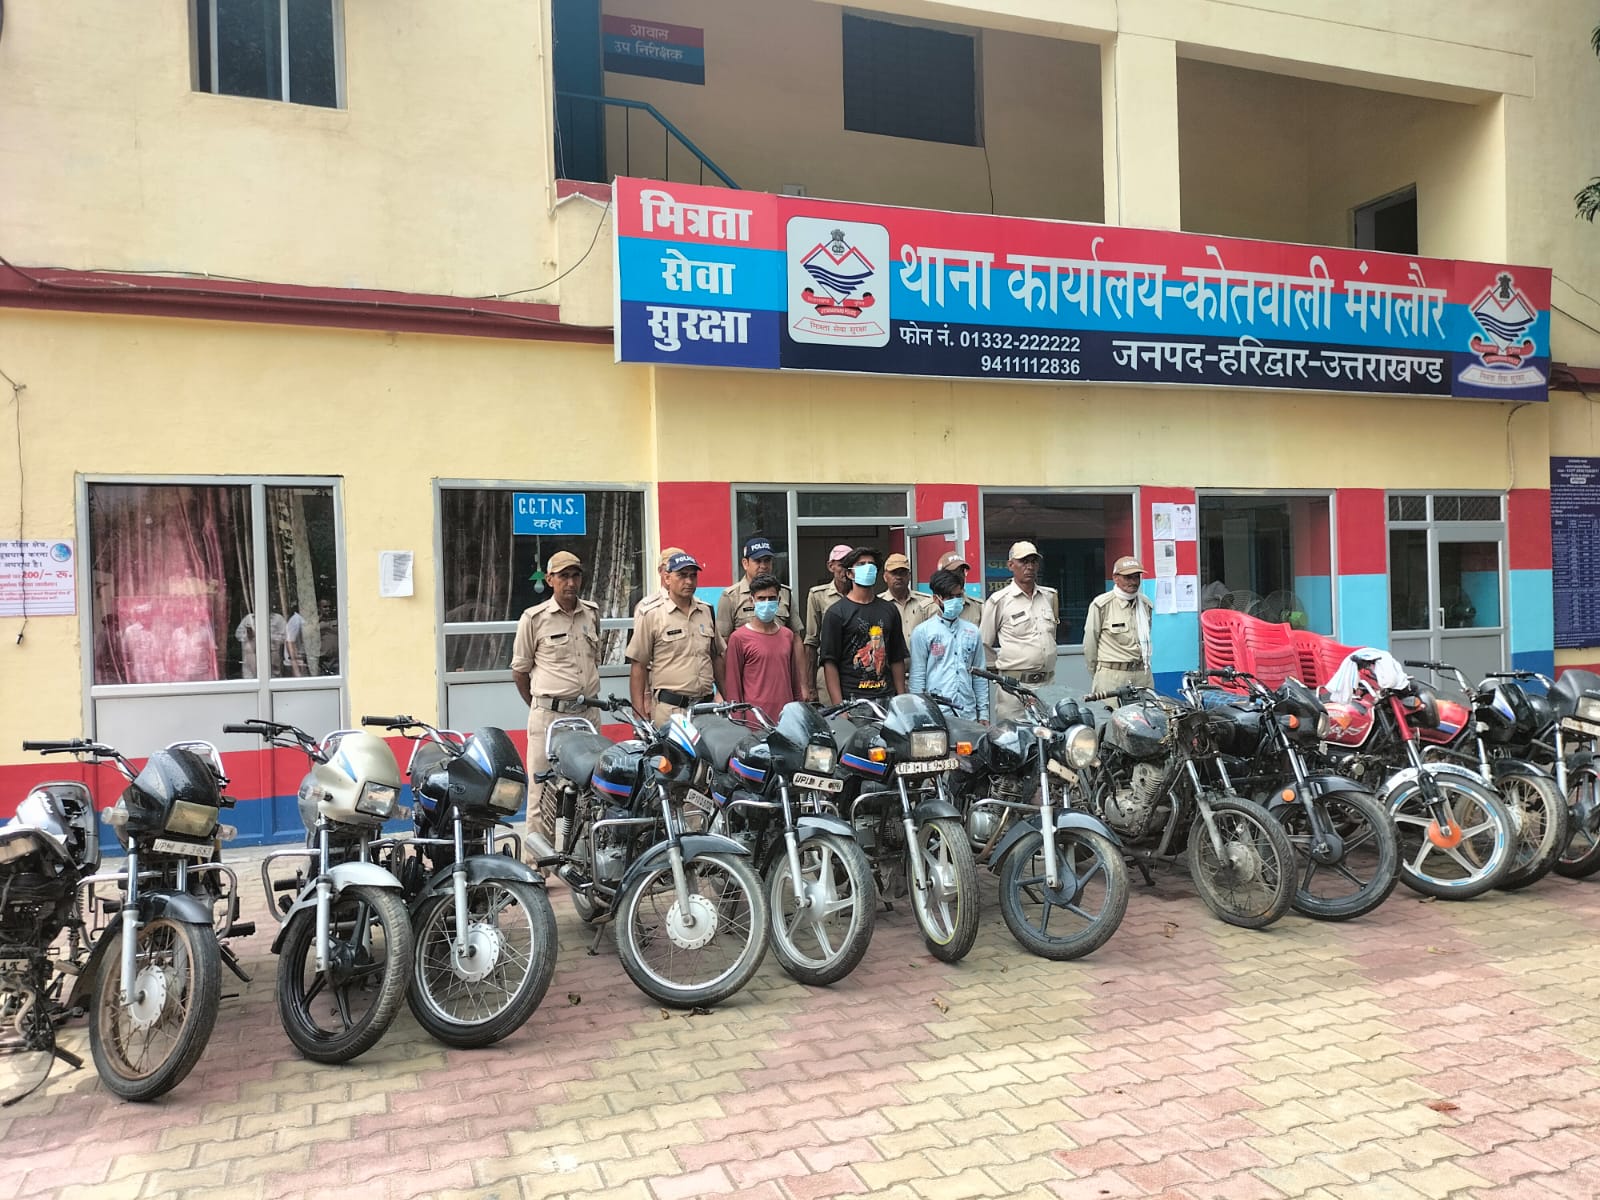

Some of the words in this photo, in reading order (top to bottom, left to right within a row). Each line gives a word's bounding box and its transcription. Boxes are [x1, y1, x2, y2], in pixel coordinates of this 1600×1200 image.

[614, 40, 631, 55] उप
[630, 24, 669, 40] आवास
[639, 188, 753, 242] मित्रता
[660, 248, 737, 296] सेवा
[899, 243, 995, 311] थाना
[1006, 236, 1335, 331] कार्यालय-कोतवाली
[1343, 259, 1448, 340] मंगलौर
[645, 304, 752, 352] सुरक्षा
[899, 321, 934, 347] फोन
[936, 327, 955, 347] नं.
[959, 332, 1081, 353] 01332-222222
[980, 354, 1081, 375] 9411112836
[1111, 334, 1444, 386] जनपद-हरिद्वार-उत्तराखण्ड
[533, 518, 564, 531] कक्ष
